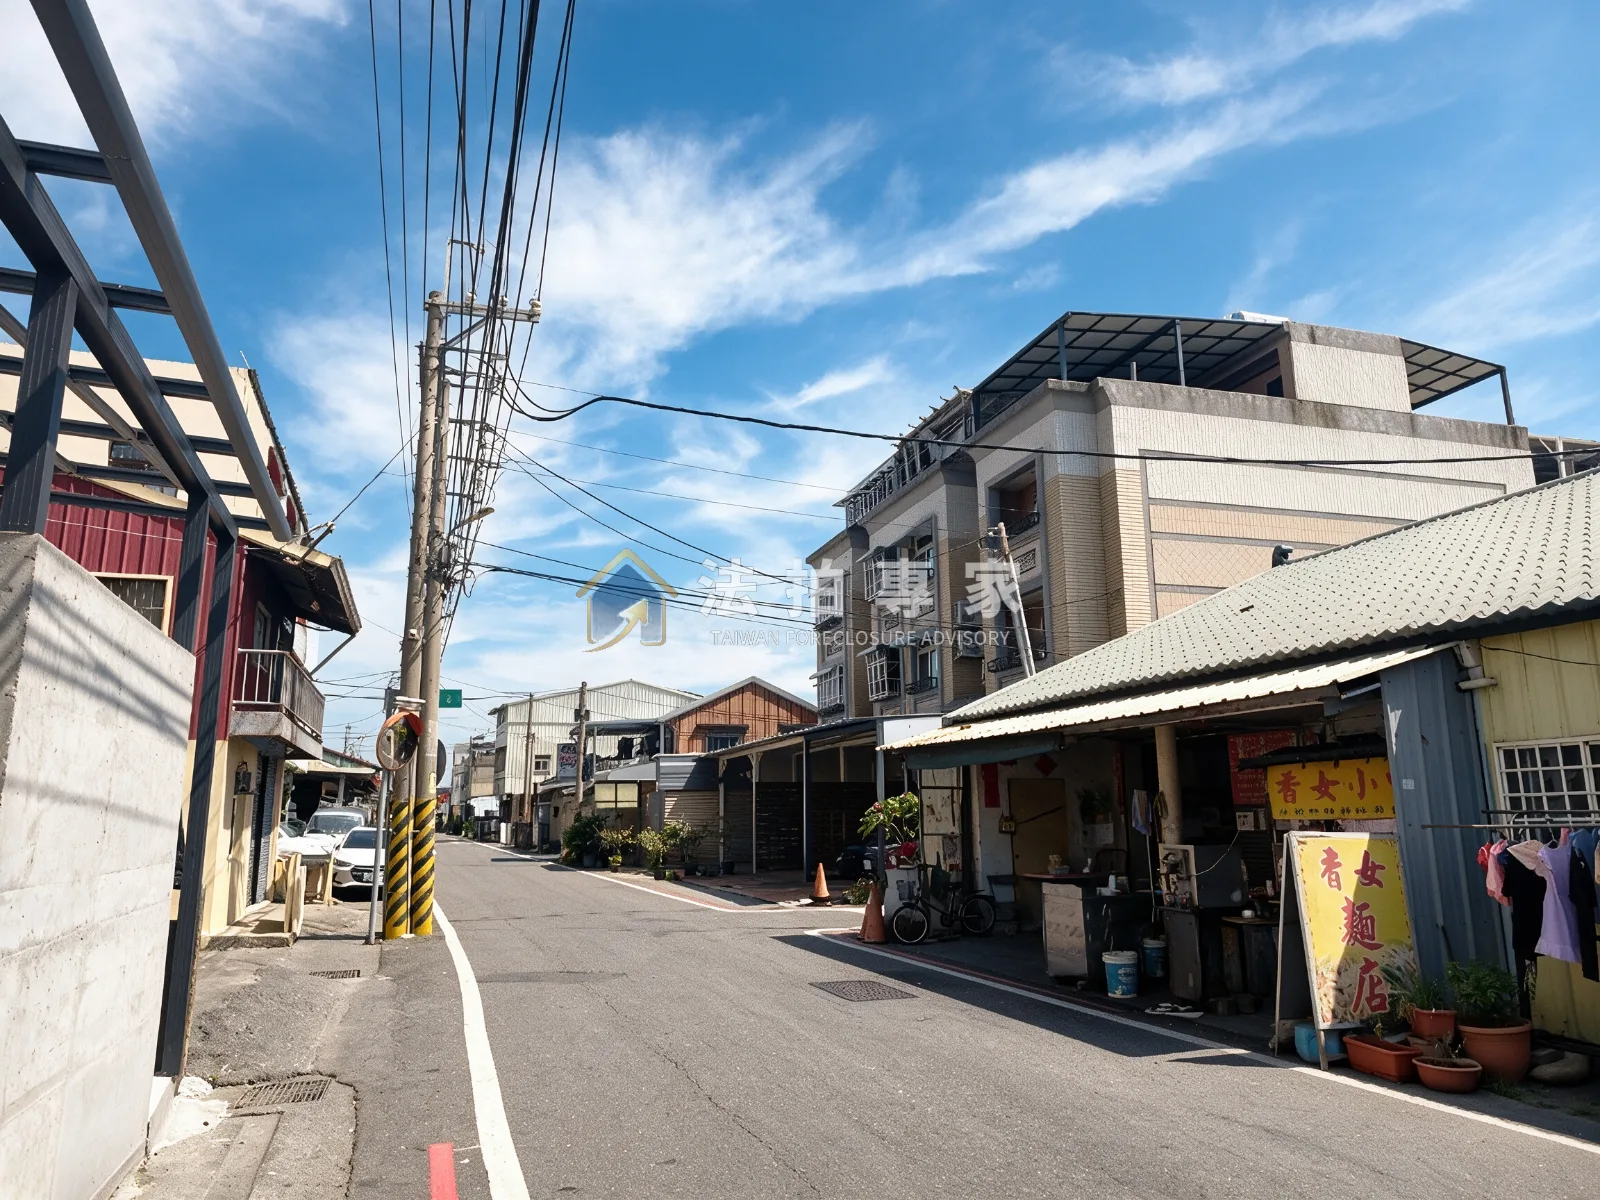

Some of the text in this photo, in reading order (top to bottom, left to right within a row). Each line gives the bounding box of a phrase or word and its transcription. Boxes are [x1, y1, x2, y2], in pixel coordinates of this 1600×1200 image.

[1275, 767, 1393, 804] 香女小
[1320, 846, 1387, 891] 香女
